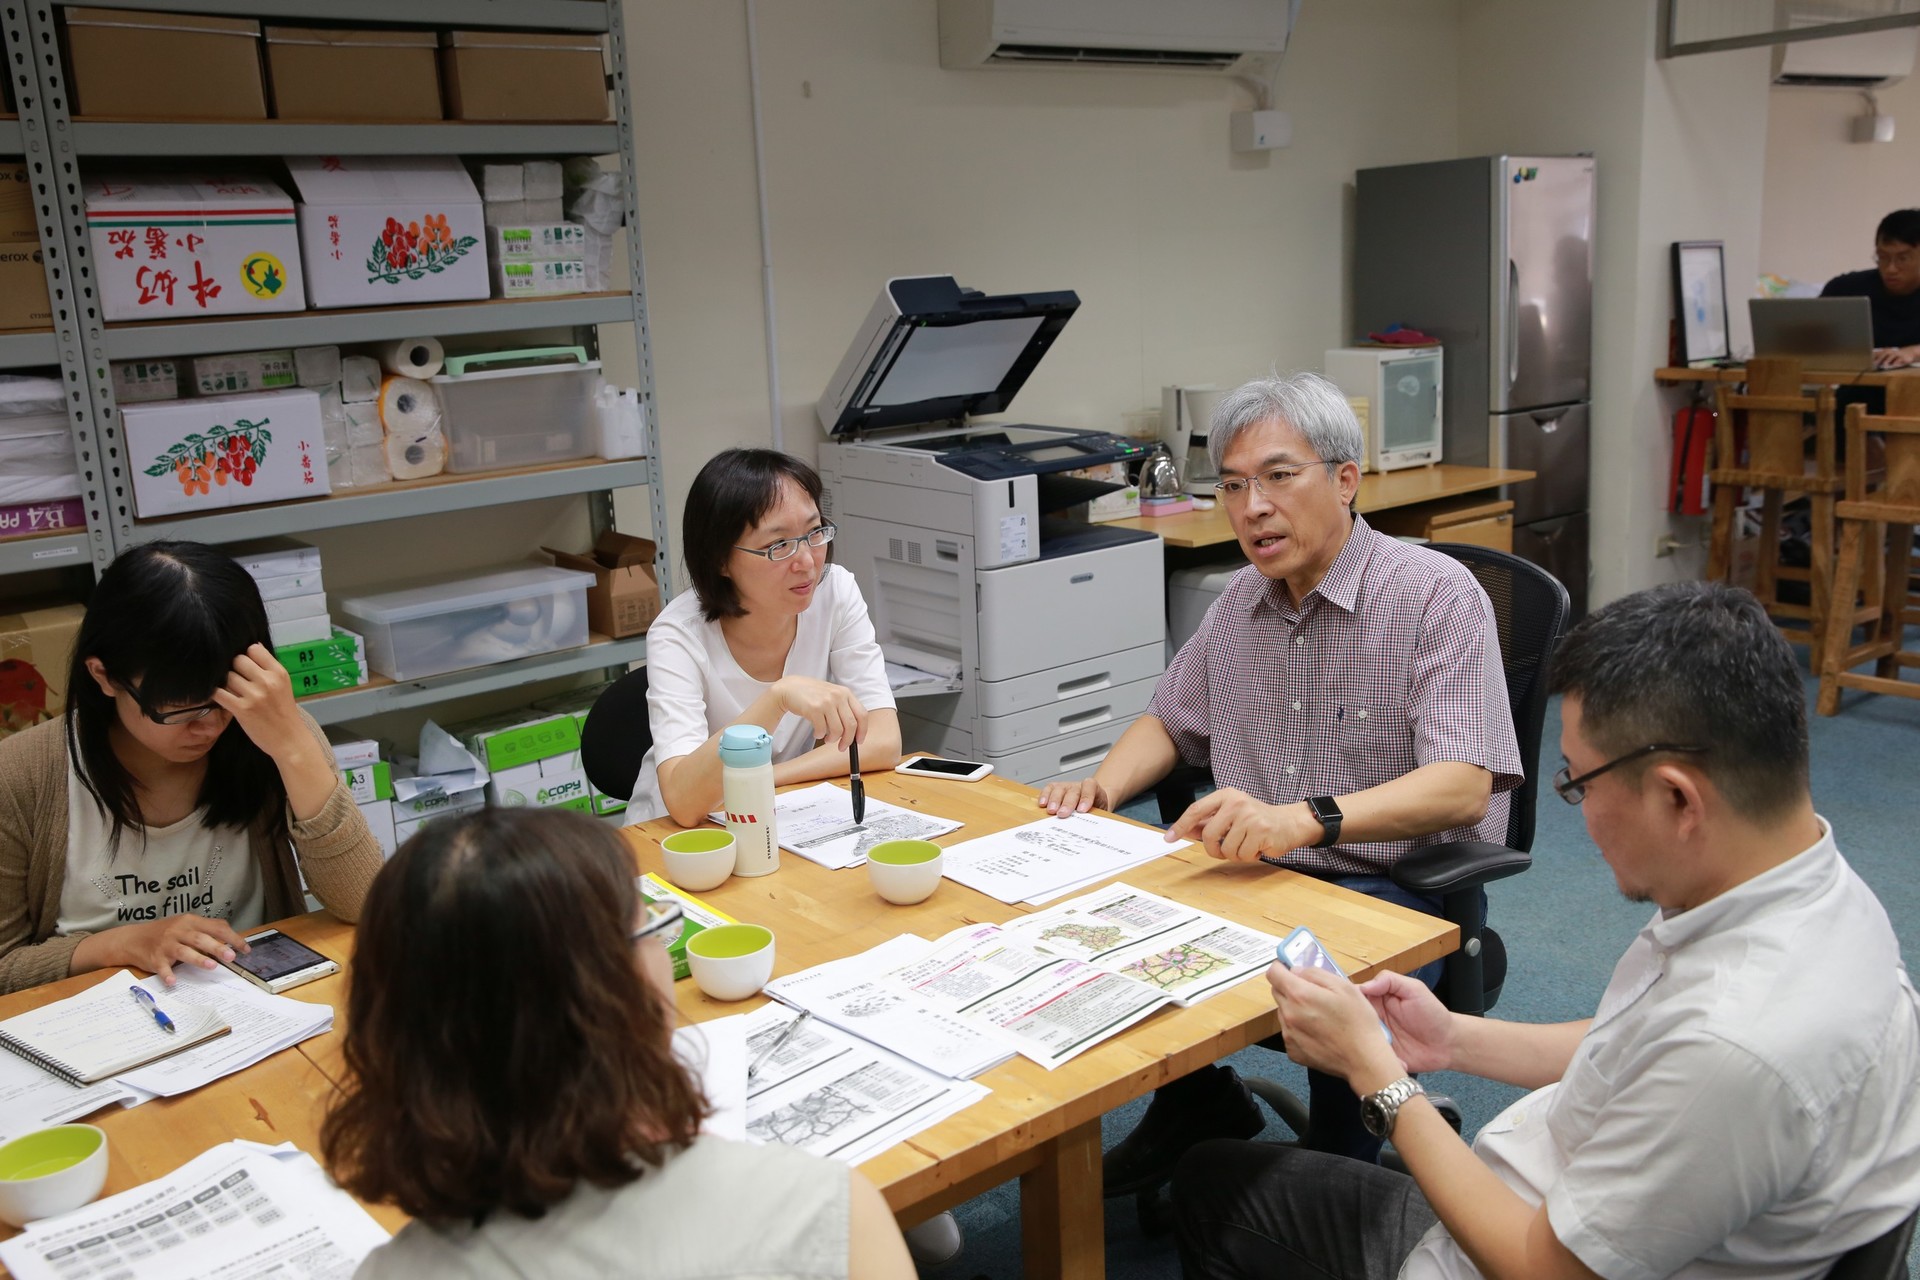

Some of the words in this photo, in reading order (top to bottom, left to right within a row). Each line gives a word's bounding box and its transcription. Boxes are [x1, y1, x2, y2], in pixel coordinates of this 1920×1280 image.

[136, 260, 222, 308] 牛奶
[27, 508, 65, 529] B4
[299, 650, 314, 662] A3
[303, 674, 318, 687] A3
[350, 774, 365, 785] A3
[548, 780, 581, 797] COPY
[115, 874, 161, 895] The
[166, 866, 199, 891] sail
[118, 905, 156, 921] was
[162, 885, 213, 917] filled
